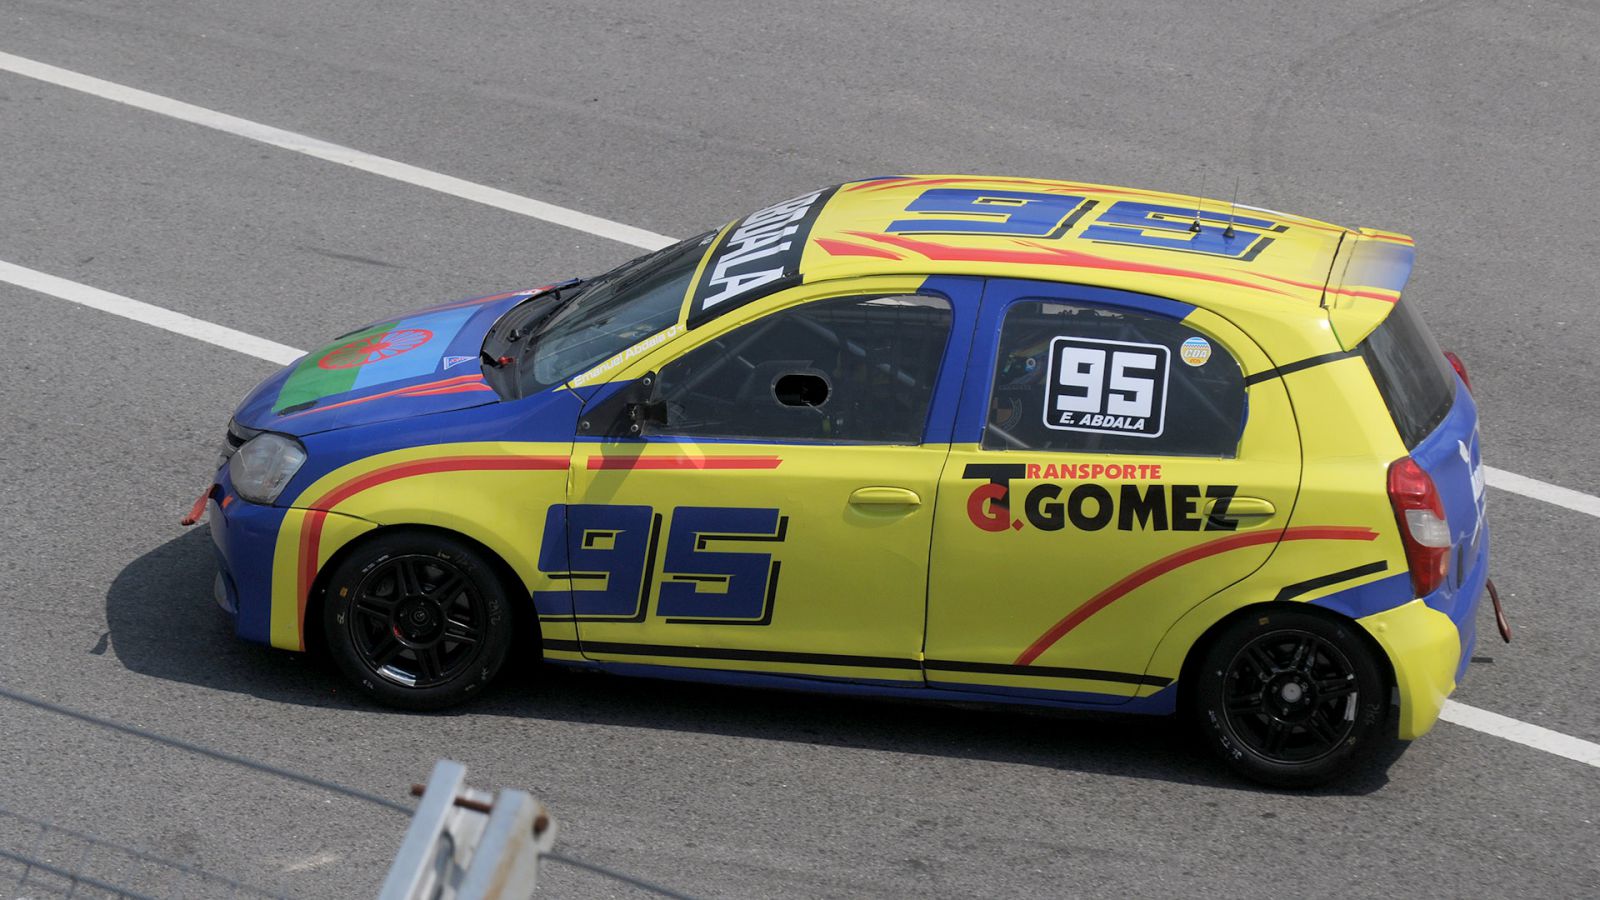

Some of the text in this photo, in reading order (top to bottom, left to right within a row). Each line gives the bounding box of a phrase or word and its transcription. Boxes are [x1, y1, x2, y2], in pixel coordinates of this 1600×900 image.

[702, 187, 830, 311] BDALA
[884, 188, 1290, 262] 95
[573, 352, 623, 387] Emanuel
[1056, 347, 1157, 418] 95
[1059, 411, 1145, 431] E. ABDALA
[531, 503, 789, 626] 95
